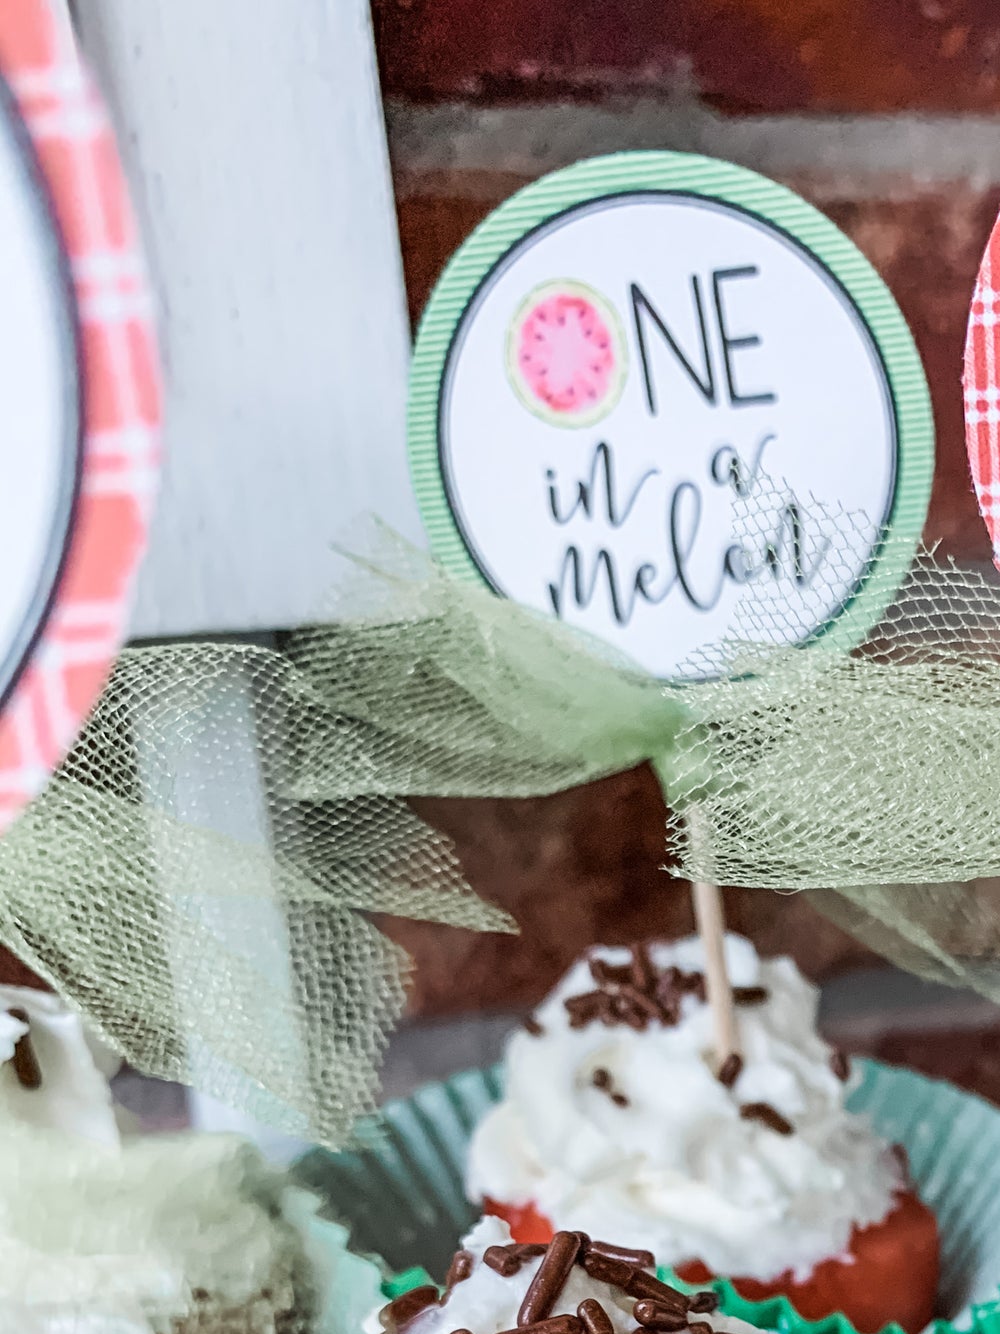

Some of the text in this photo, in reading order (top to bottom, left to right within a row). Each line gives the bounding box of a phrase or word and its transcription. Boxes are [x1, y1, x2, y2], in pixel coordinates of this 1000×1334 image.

[544, 433, 778, 528] in a
[547, 481, 832, 628] melon
